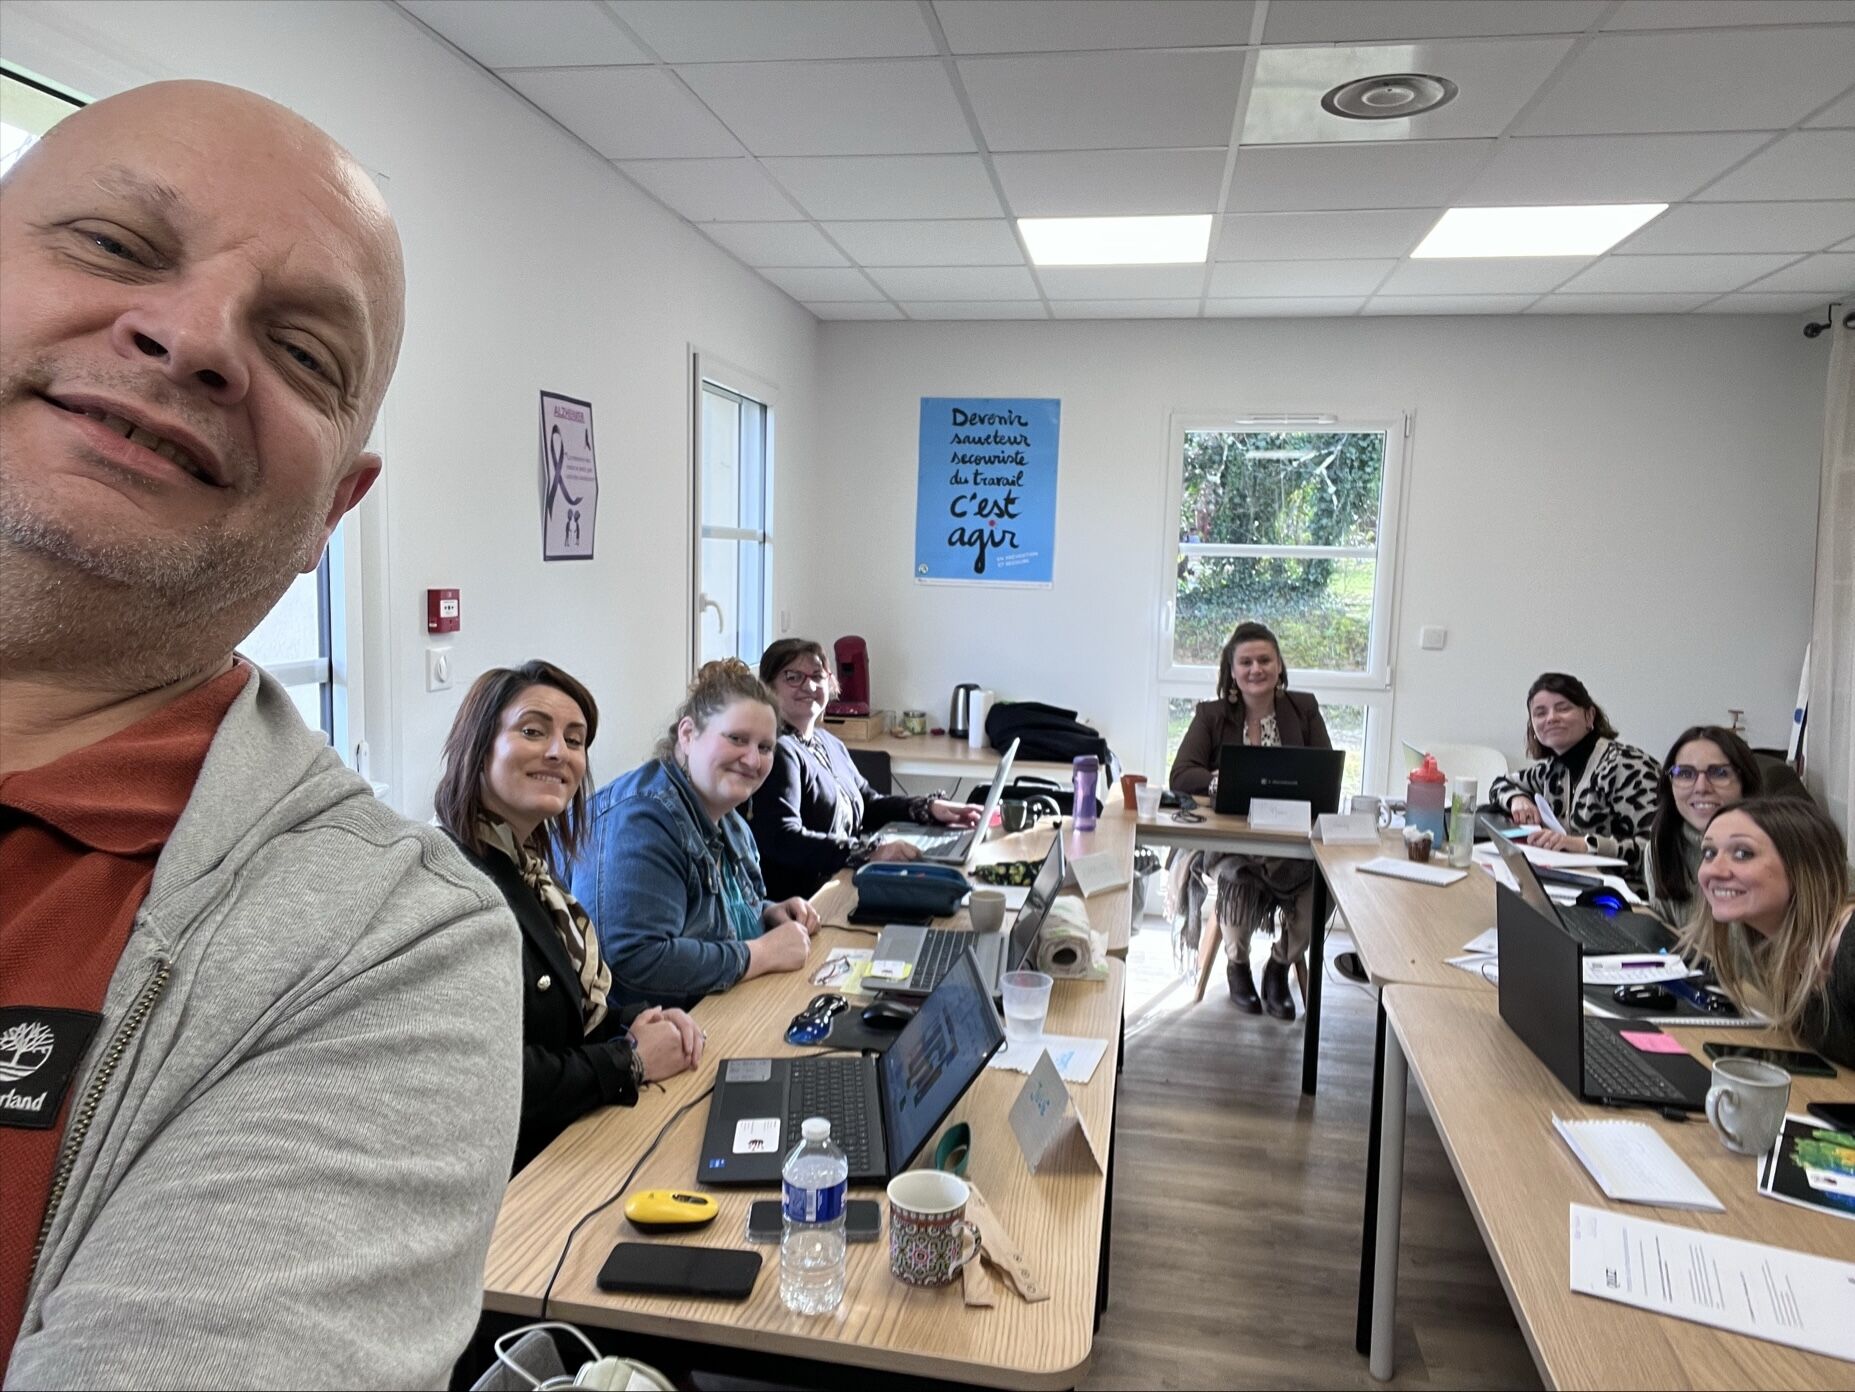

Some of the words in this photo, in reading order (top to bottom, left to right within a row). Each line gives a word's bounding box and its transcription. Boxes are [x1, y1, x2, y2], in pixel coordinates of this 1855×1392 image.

[952, 408, 1029, 427] Devenir
[950, 430, 1031, 447] sauveteur
[951, 450, 1028, 466] secouriste
[950, 469, 968, 485] du
[973, 470, 1024, 487] travail
[948, 519, 1019, 574] agir
